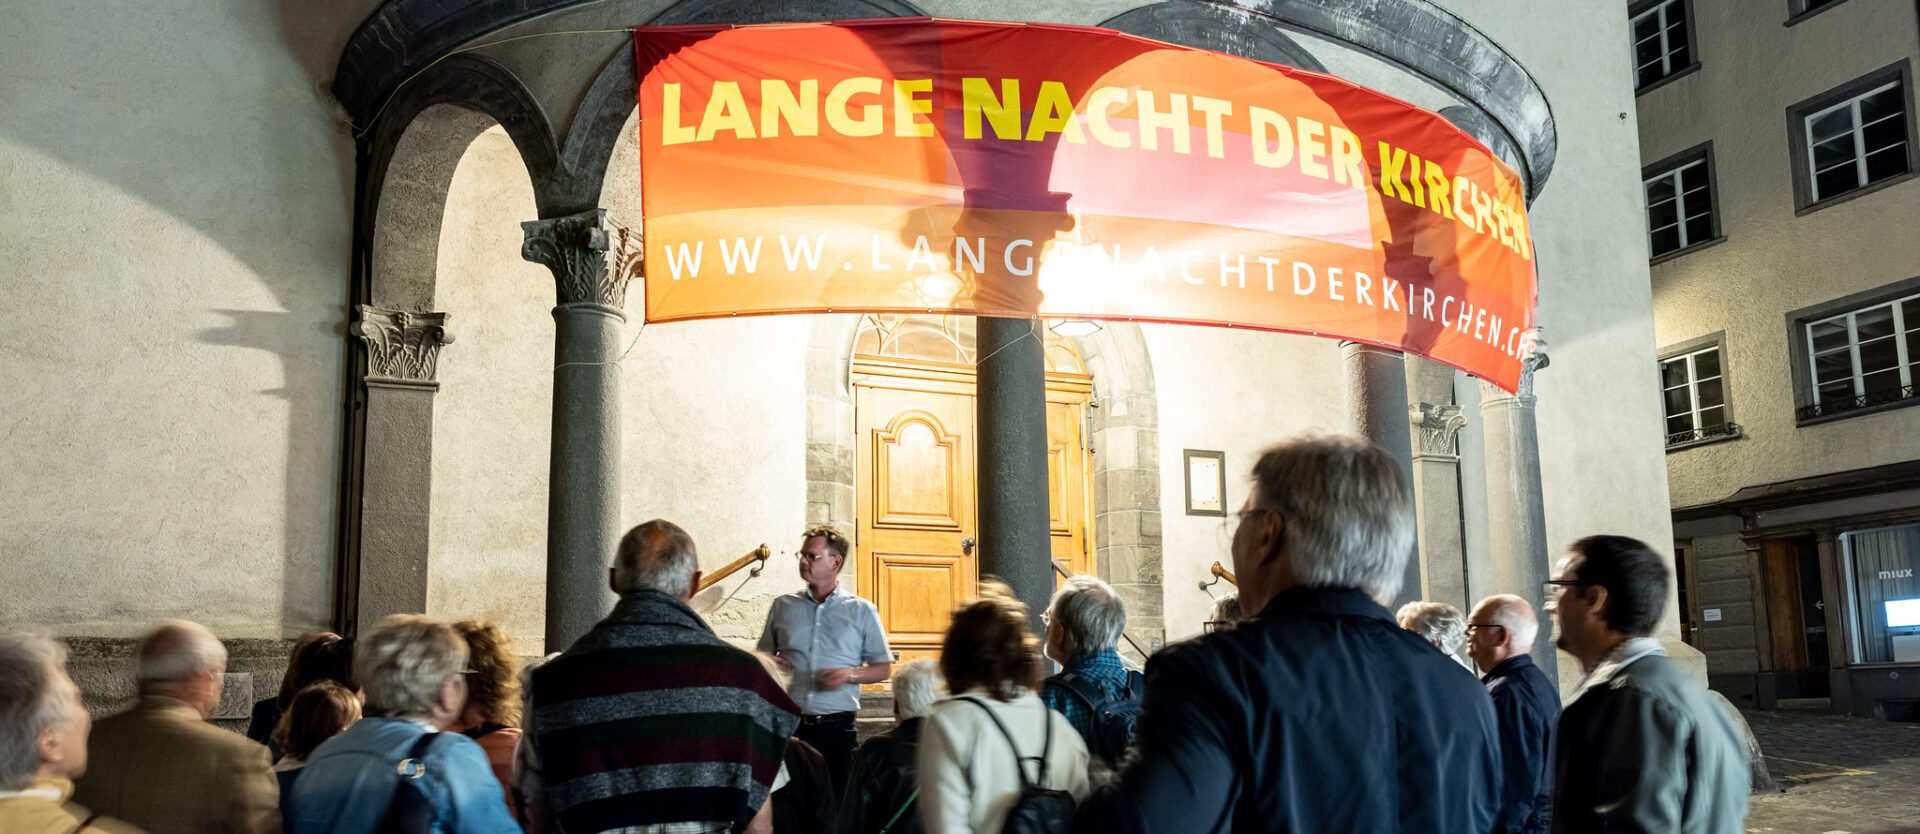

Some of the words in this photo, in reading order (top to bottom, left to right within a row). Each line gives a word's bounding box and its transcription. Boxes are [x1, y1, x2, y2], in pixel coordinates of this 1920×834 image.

[661, 77, 935, 146] LANGE
[962, 77, 1232, 159] NACHT
[1249, 105, 1366, 189] DER
[1378, 140, 1532, 261] KIRCHEN
